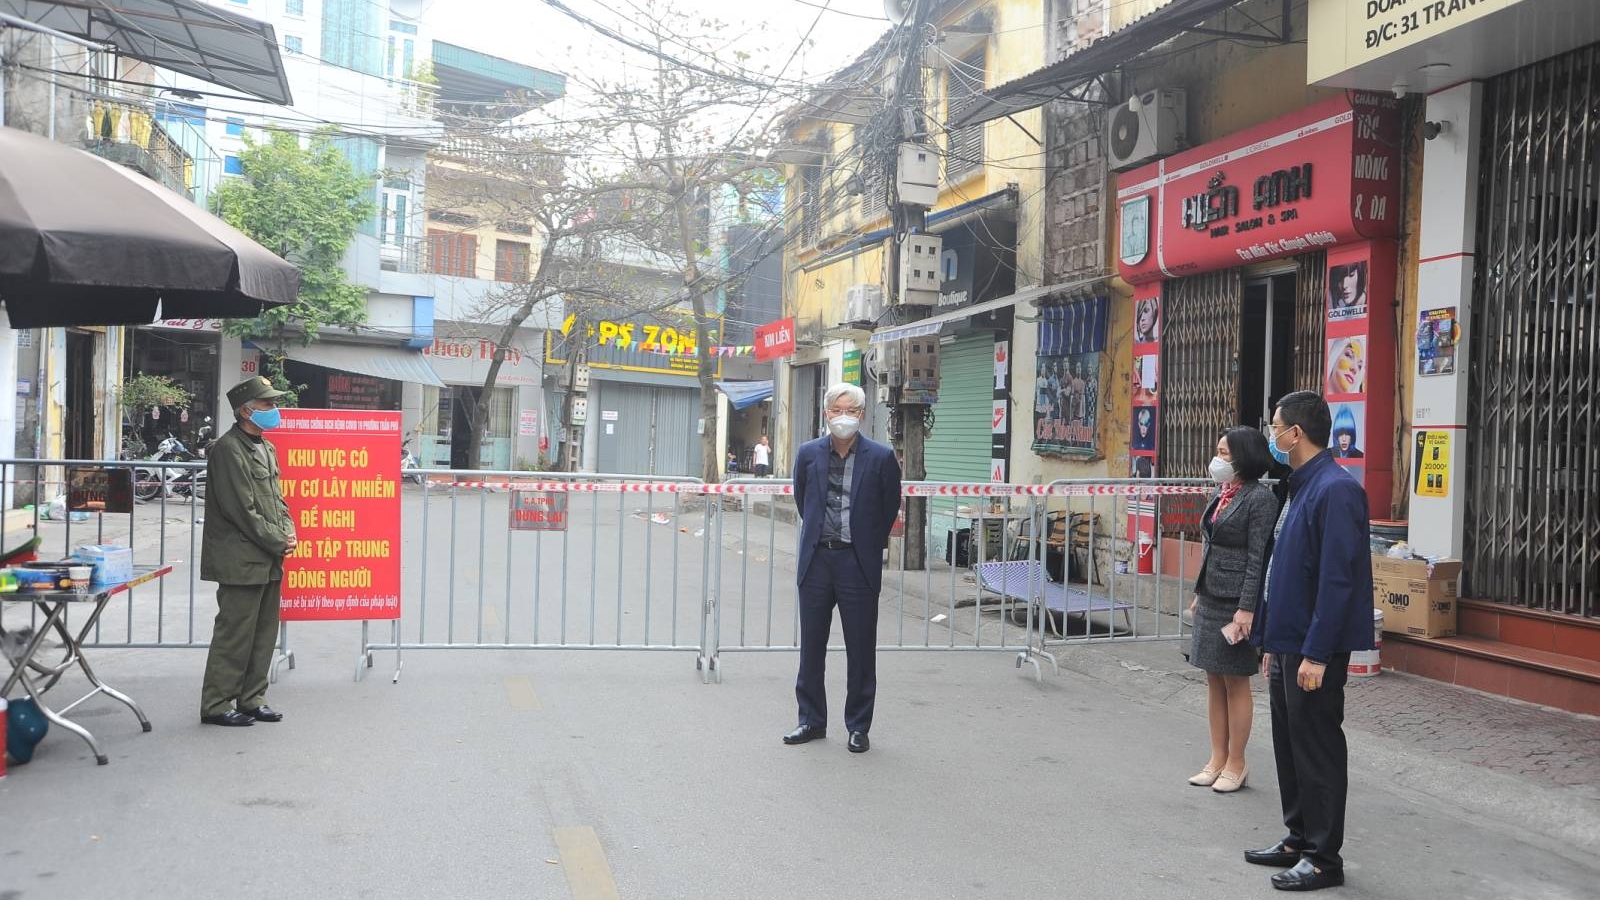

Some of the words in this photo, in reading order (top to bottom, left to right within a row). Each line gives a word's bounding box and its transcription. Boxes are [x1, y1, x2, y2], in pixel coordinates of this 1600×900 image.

[1365, 23, 1397, 48] Đ/C:
[1401, 12, 1419, 35] 31
[1354, 148, 1389, 181] MÓNG
[1354, 193, 1363, 220] &
[1370, 195, 1387, 220] DA
[1210, 225, 1229, 238] HAIR
[1235, 217, 1263, 233] SALON
[1280, 208, 1298, 222] SPA
[938, 290, 968, 306] Boutique
[1328, 308, 1362, 320] GOLDWELL
[775, 326, 790, 345] LIÊN
[287, 449, 316, 467] KHU
[320, 447, 346, 471] VỰC
[350, 446, 368, 468] CÓ
[280, 479, 296, 498] UY
[300, 478, 320, 498] CƠ
[323, 476, 348, 497] LÂY
[351, 473, 396, 498] NHIỄM
[322, 510, 356, 532] NGHỊ
[315, 537, 342, 562] TẬP
[345, 540, 390, 558] TRUNG
[288, 567, 327, 588] ĐÔNG
[329, 566, 372, 588] NGƯỜI
[1389, 593, 1409, 607] OMO
